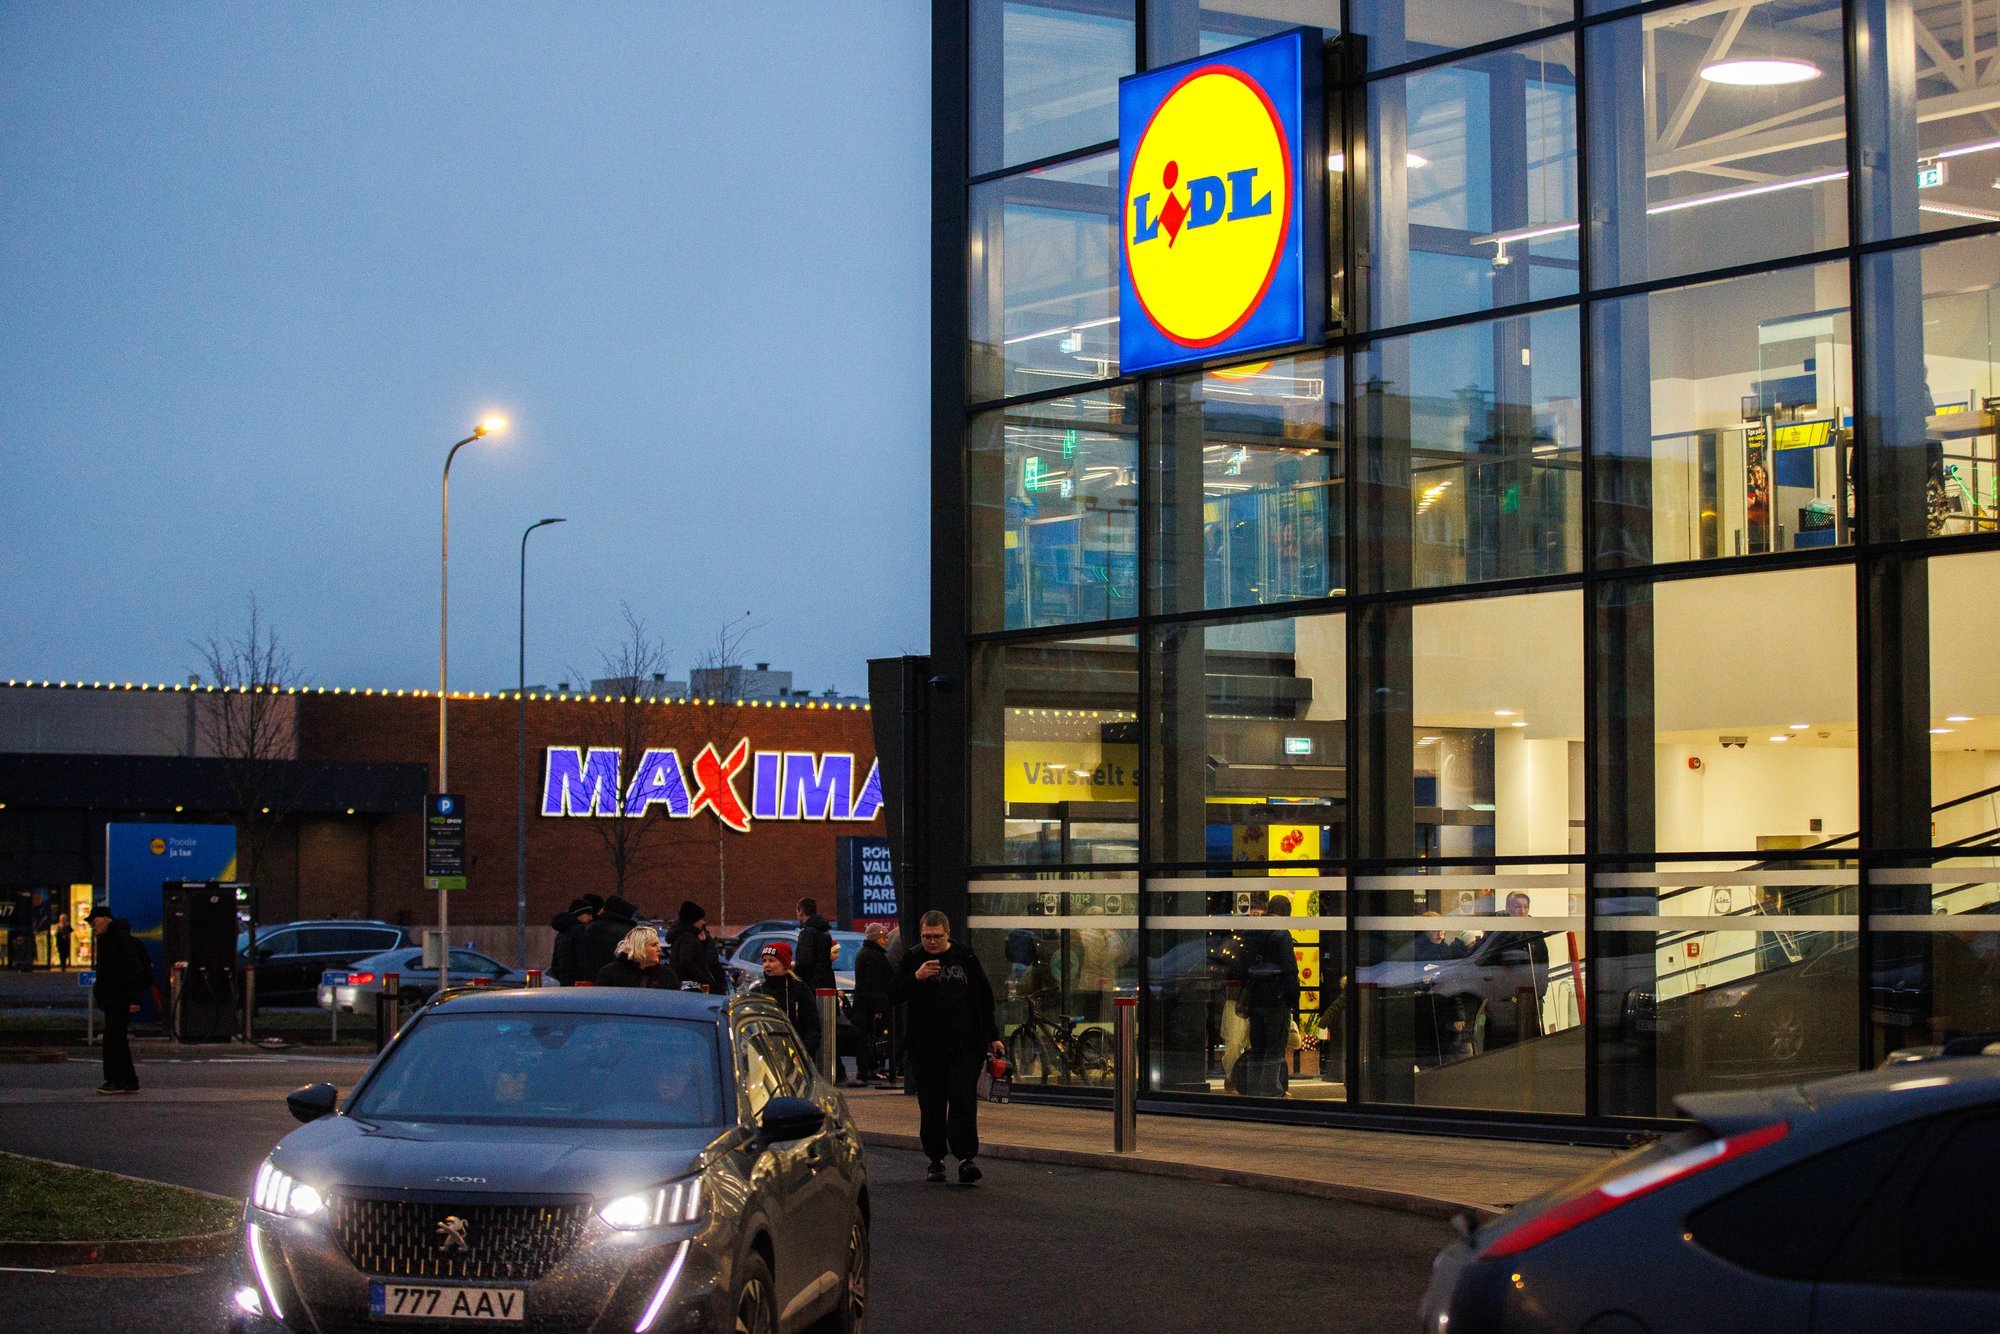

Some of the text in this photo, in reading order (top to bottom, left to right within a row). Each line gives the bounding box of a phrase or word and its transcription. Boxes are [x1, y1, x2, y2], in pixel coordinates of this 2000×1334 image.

[1023, 761, 1124, 786] Värskelt
[441, 799, 450, 812] P
[863, 902, 898, 914] HIND
[394, 1288, 515, 1317] 777 AAV
